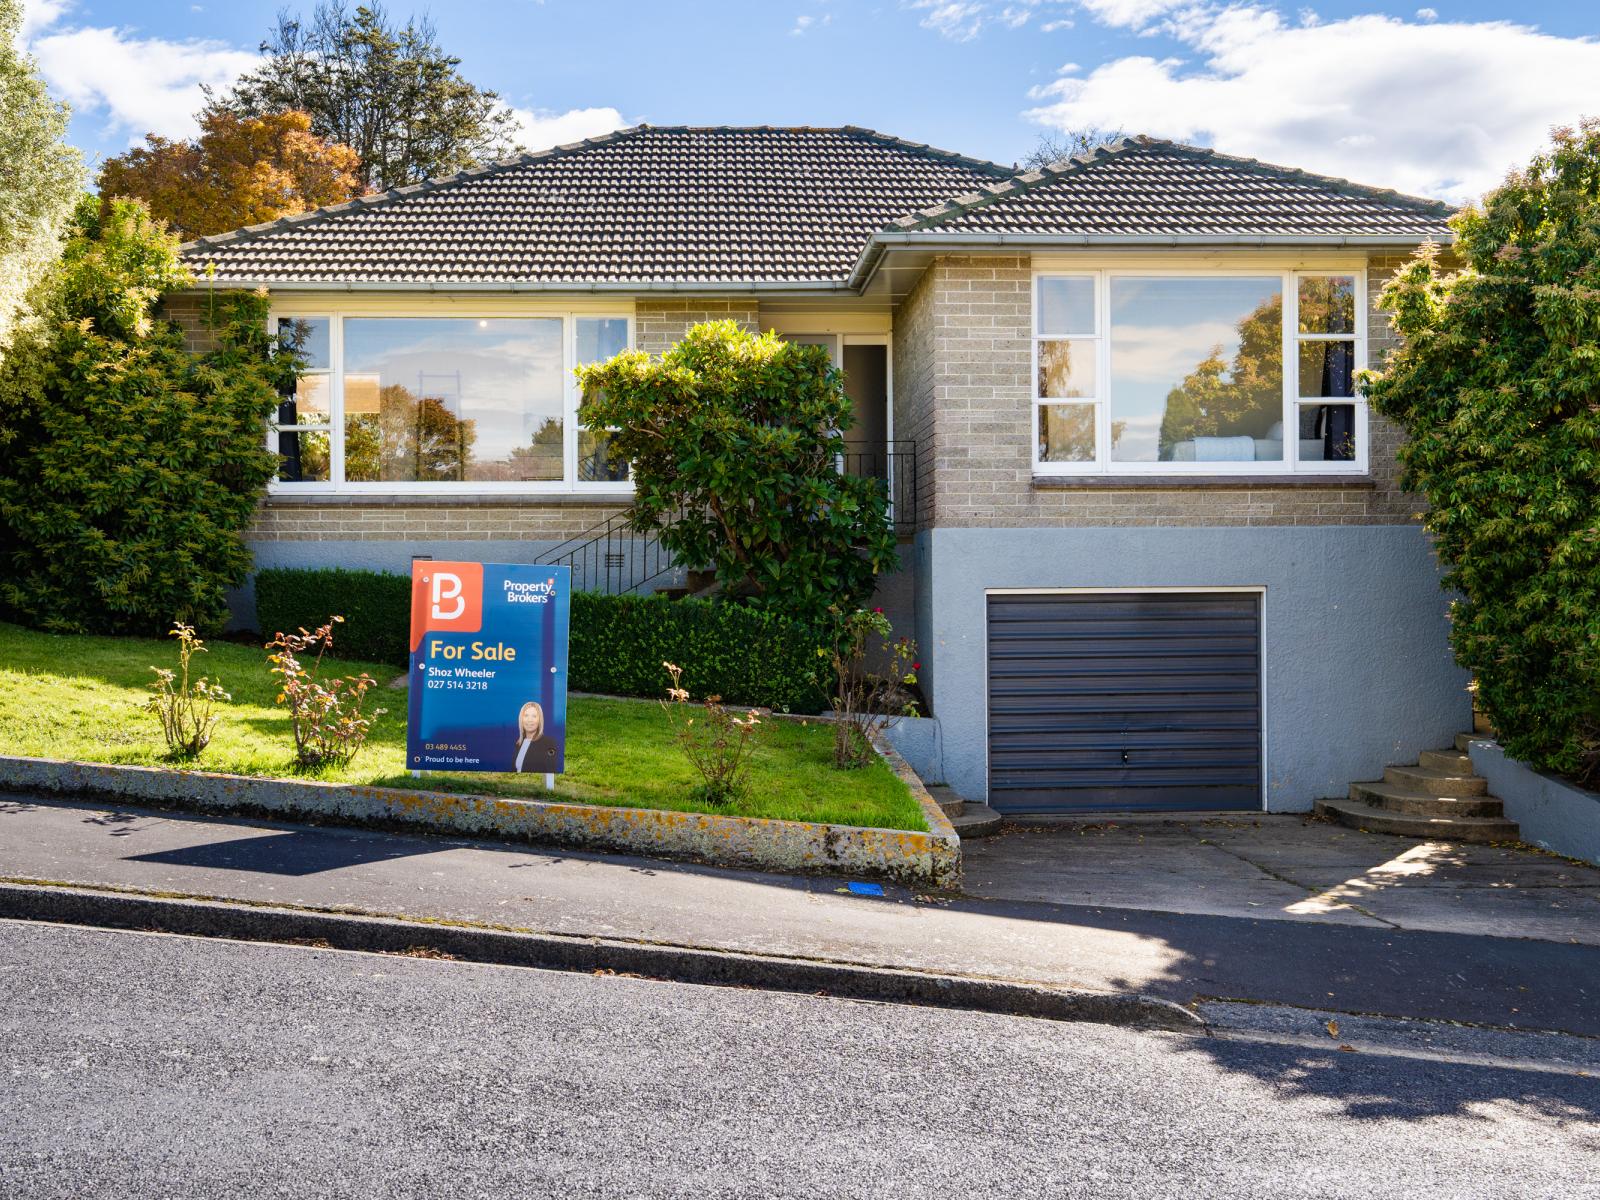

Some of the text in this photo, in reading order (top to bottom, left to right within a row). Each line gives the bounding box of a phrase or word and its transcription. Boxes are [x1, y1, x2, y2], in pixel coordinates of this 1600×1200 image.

[504, 580, 552, 595] Property
[507, 592, 548, 603] Brokers
[431, 640, 516, 661] For Sale
[428, 667, 496, 678] Shoz Wheeler
[447, 681, 464, 689] 514
[466, 682, 488, 690] 3218
